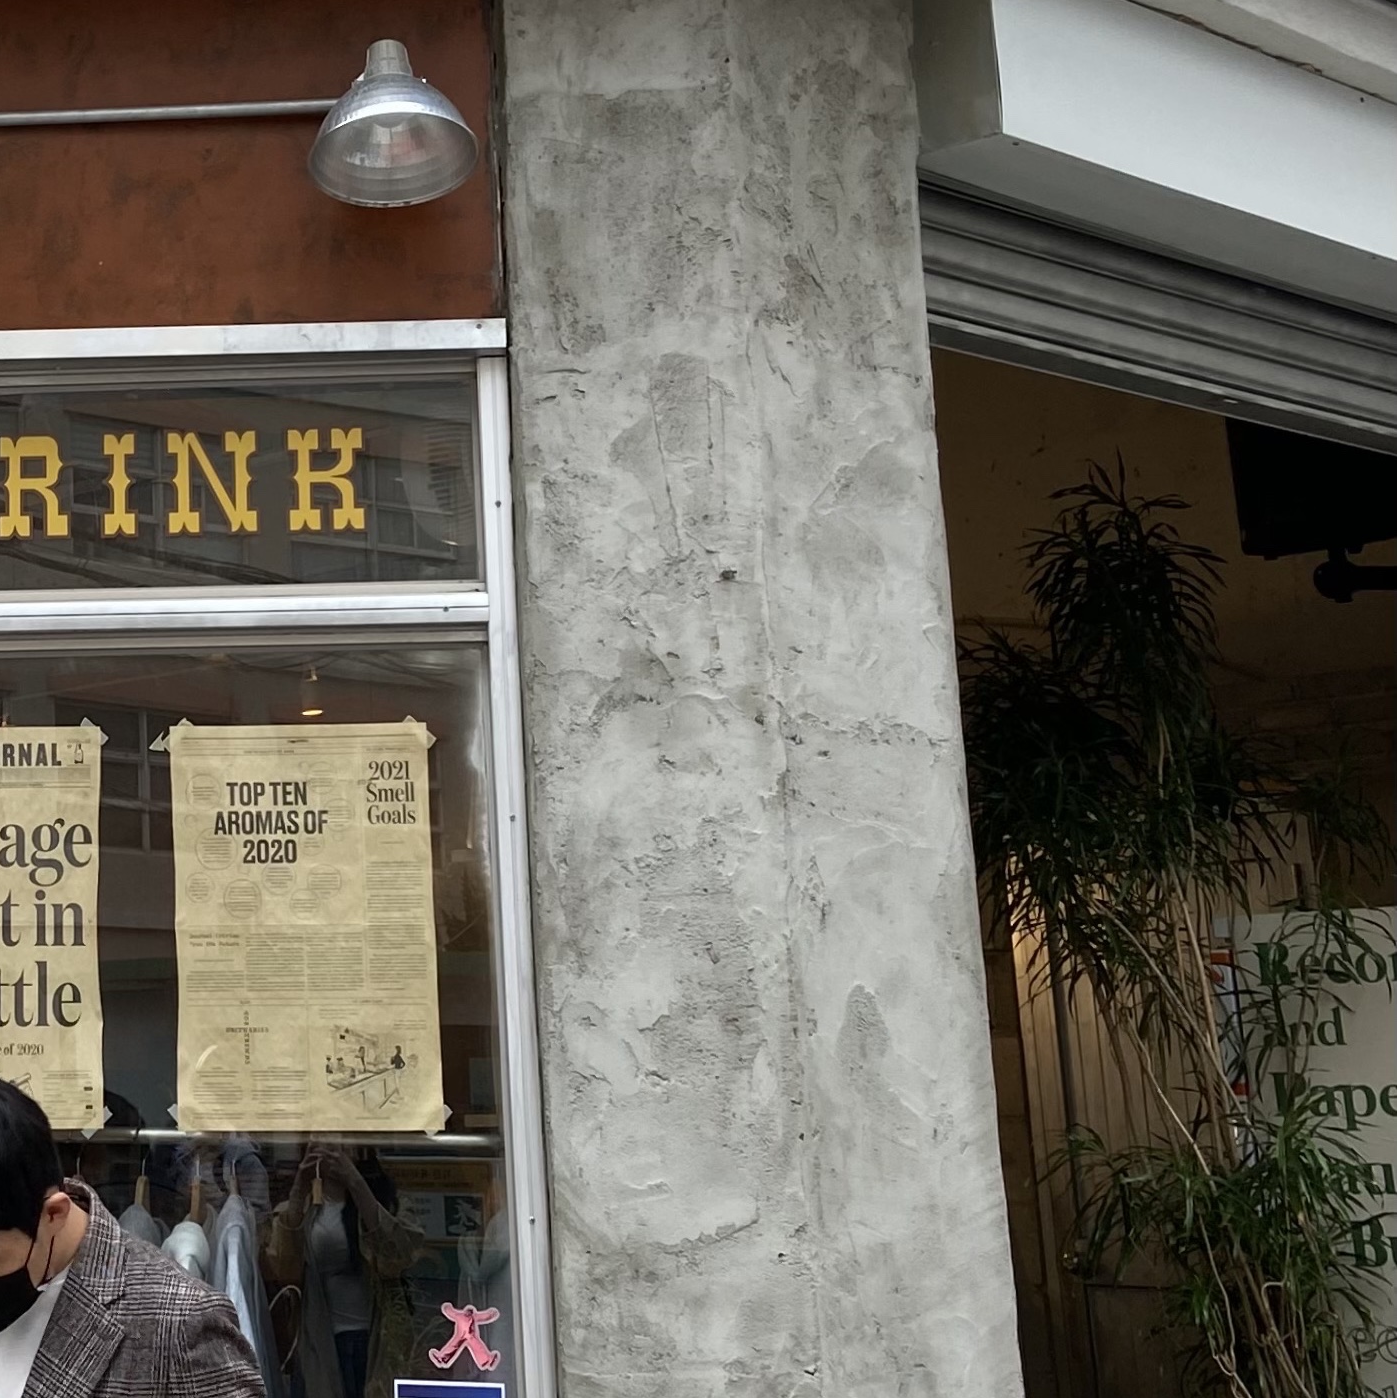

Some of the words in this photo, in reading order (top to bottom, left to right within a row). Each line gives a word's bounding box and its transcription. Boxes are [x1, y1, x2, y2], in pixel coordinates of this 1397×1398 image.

[368, 760, 411, 781] 2021
[226, 782, 265, 806] TOP
[269, 781, 308, 806] TEN
[366, 782, 416, 803] Smell
[214, 810, 300, 836] AROMAS
[303, 810, 329, 835] OF
[367, 803, 417, 825] Goals
[242, 839, 298, 864] 2020
[33, 889, 87, 947] in
[3, 1042, 16, 1056] of
[17, 1043, 44, 1056] 2020
